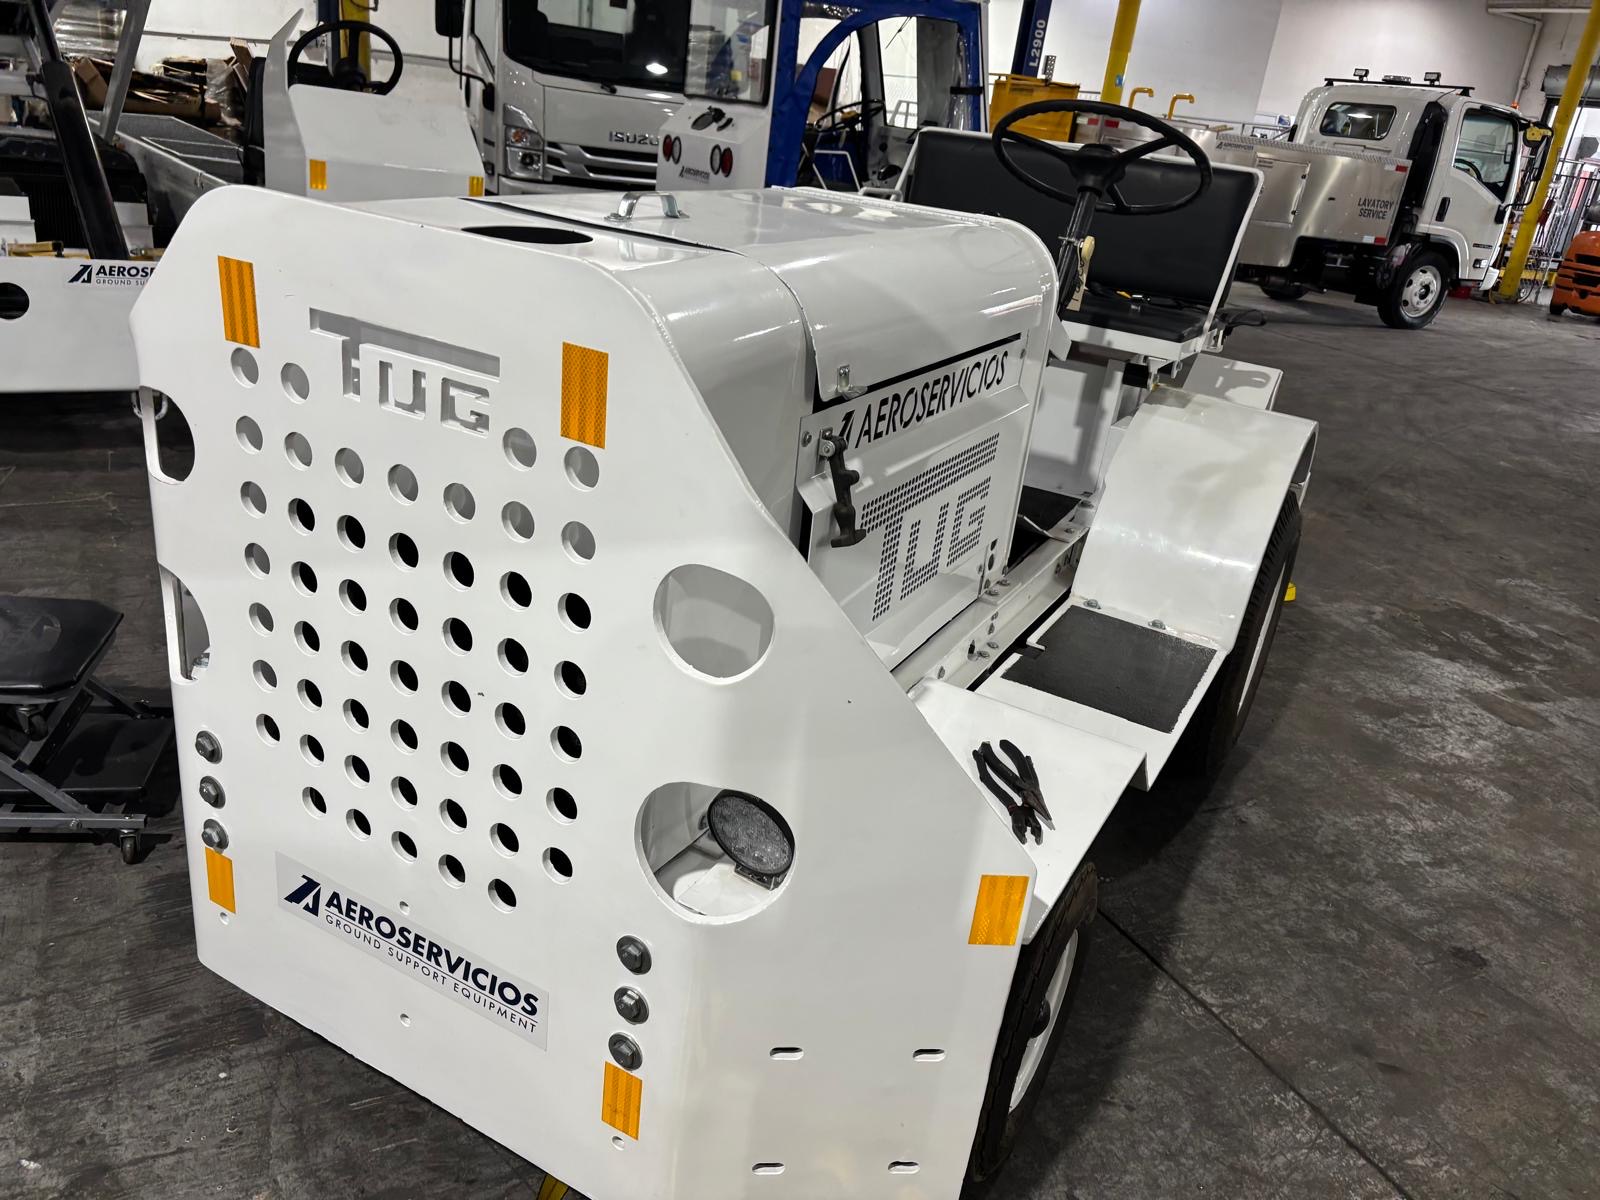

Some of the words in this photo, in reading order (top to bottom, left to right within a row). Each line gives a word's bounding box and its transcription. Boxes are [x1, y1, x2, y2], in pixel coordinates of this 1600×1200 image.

[1029, 20, 1046, 67] L2900
[608, 131, 660, 146] ISUZU
[1358, 197, 1395, 210] LAVATORY
[1359, 208, 1388, 220] SERVICE
[96, 278, 132, 286] GROUND
[309, 307, 500, 438] TUG
[854, 350, 1009, 449] AEROSERVICIOS
[860, 432, 1000, 621] TUG
[324, 891, 539, 1017] AEROSERVICIOS
[325, 914, 382, 949] GROUND
[387, 947, 448, 985] SUPPORT
[453, 982, 538, 1034] EQUIPMENT
